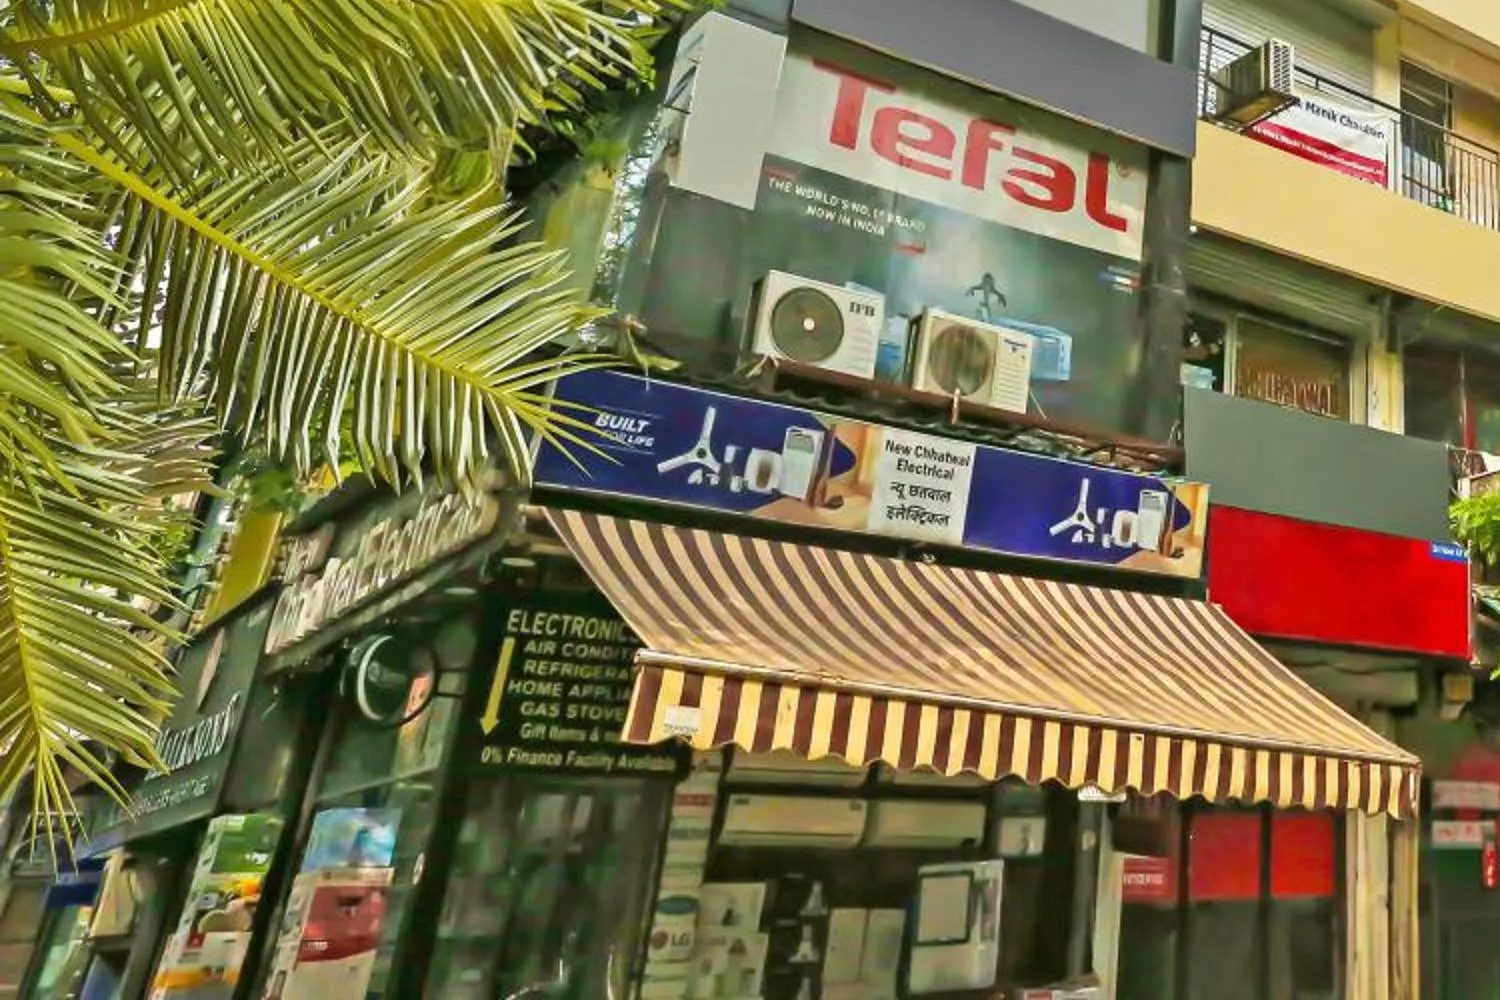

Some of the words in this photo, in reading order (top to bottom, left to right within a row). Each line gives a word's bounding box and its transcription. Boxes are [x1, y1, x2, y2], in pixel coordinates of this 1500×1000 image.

[812, 57, 1128, 233] Tefal
[768, 177, 793, 193] THE
[795, 184, 849, 210] WORLD'S
[805, 204, 835, 221] NOW
[837, 213, 851, 228] IN
[853, 217, 886, 236] INDIA
[595, 411, 650, 433] BUILT
[628, 434, 655, 448] LIFE
[885, 439, 913, 456] New
[896, 458, 955, 480] Electrical
[524, 639, 556, 656] AIR
[561, 642, 633, 660] CONDIT
[507, 679, 564, 698] HOME
[567, 684, 632, 701] APPLIA
[520, 700, 560, 718] GAS
[520, 722, 545, 741] Gift
[507, 747, 563, 767] Finance
[671, 932, 691, 947] LG
